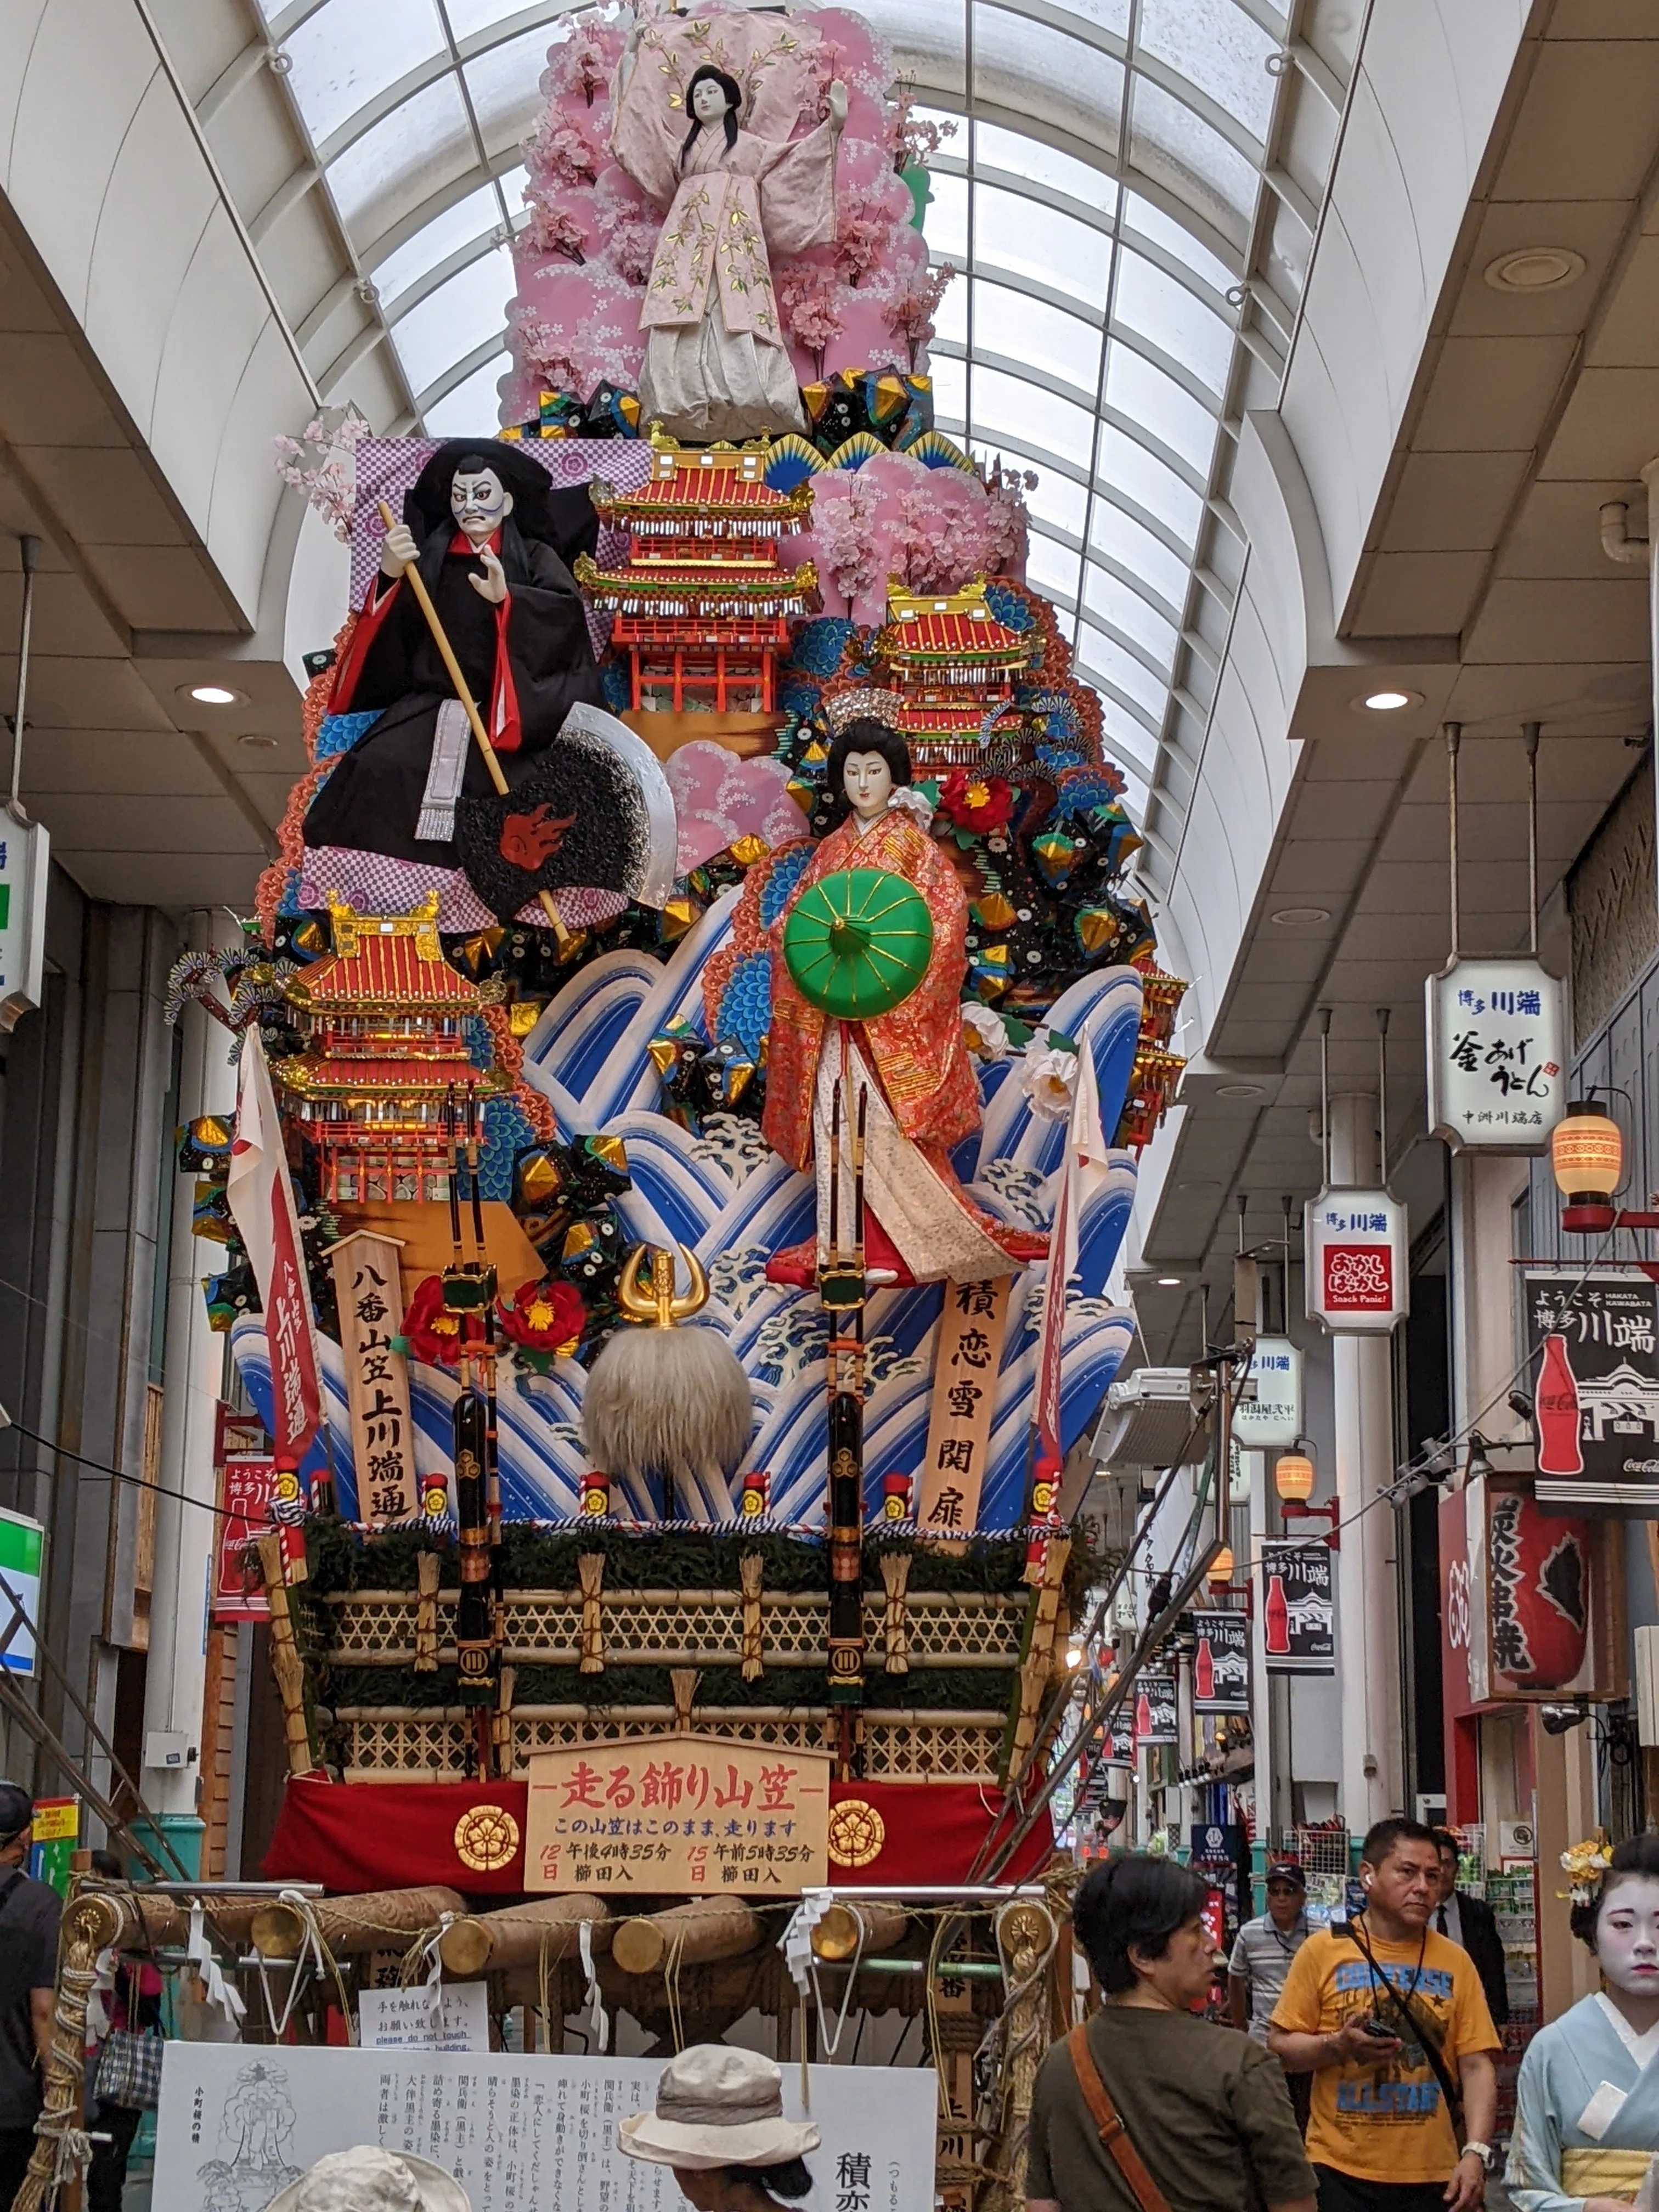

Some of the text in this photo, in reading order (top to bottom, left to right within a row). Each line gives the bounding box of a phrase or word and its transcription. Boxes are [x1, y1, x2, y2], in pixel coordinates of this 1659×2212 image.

[1458, 989, 1542, 1016] 博多川端
[1449, 1030, 1534, 1072] 釜あげ
[1325, 1212, 1387, 1232] 博多川端
[1331, 1252, 1385, 1274] おかし
[1534, 1290, 1601, 1308] ようこそ
[1534, 1309, 1656, 1354] 博多川端
[1250, 1355, 1290, 1371] 多川端
[351, 1265, 413, 1517] 八番山笠上川端通
[927, 1279, 999, 1529] 積恋雪関扉
[230, 1468, 275, 1481] ようこそ
[228, 1481, 270, 1504] 博多川
[1265, 1562, 1329, 1587] 博多川端
[539, 1841, 672, 1861] 12 午後4時35分
[687, 1842, 815, 1863] 15 午前5時35分
[543, 1863, 558, 1881] 日
[691, 1865, 706, 1883] 日
[377, 1995, 469, 2013] 手を触れなよう、
[376, 2030, 467, 2045] please do not touch
[888, 2161, 900, 2212] （つもる
